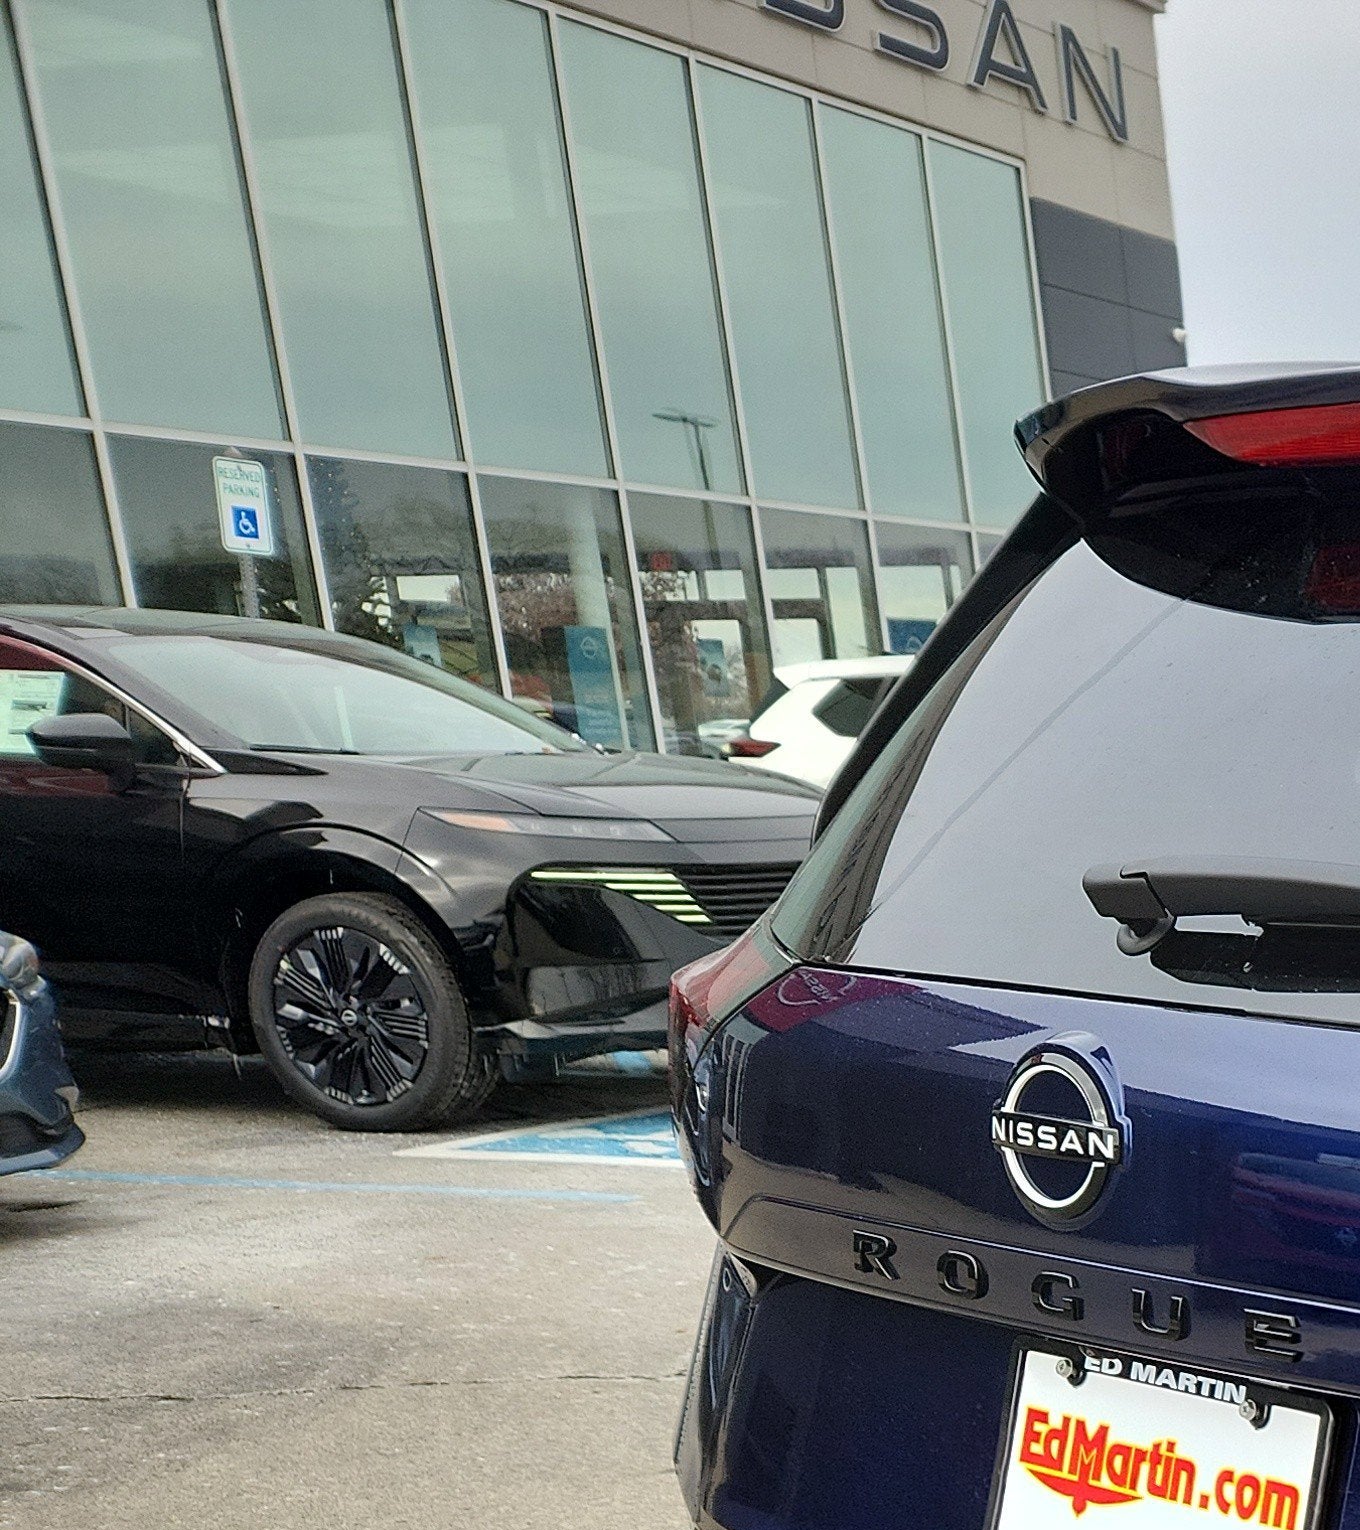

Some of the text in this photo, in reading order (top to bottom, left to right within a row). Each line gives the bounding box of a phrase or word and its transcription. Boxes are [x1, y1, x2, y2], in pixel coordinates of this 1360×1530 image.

[223, 482, 260, 498] PARKING
[991, 1115, 1115, 1160] NISSAN
[853, 1229, 1305, 1363] ROGUE
[1084, 1354, 1247, 1402] ED MARTIN
